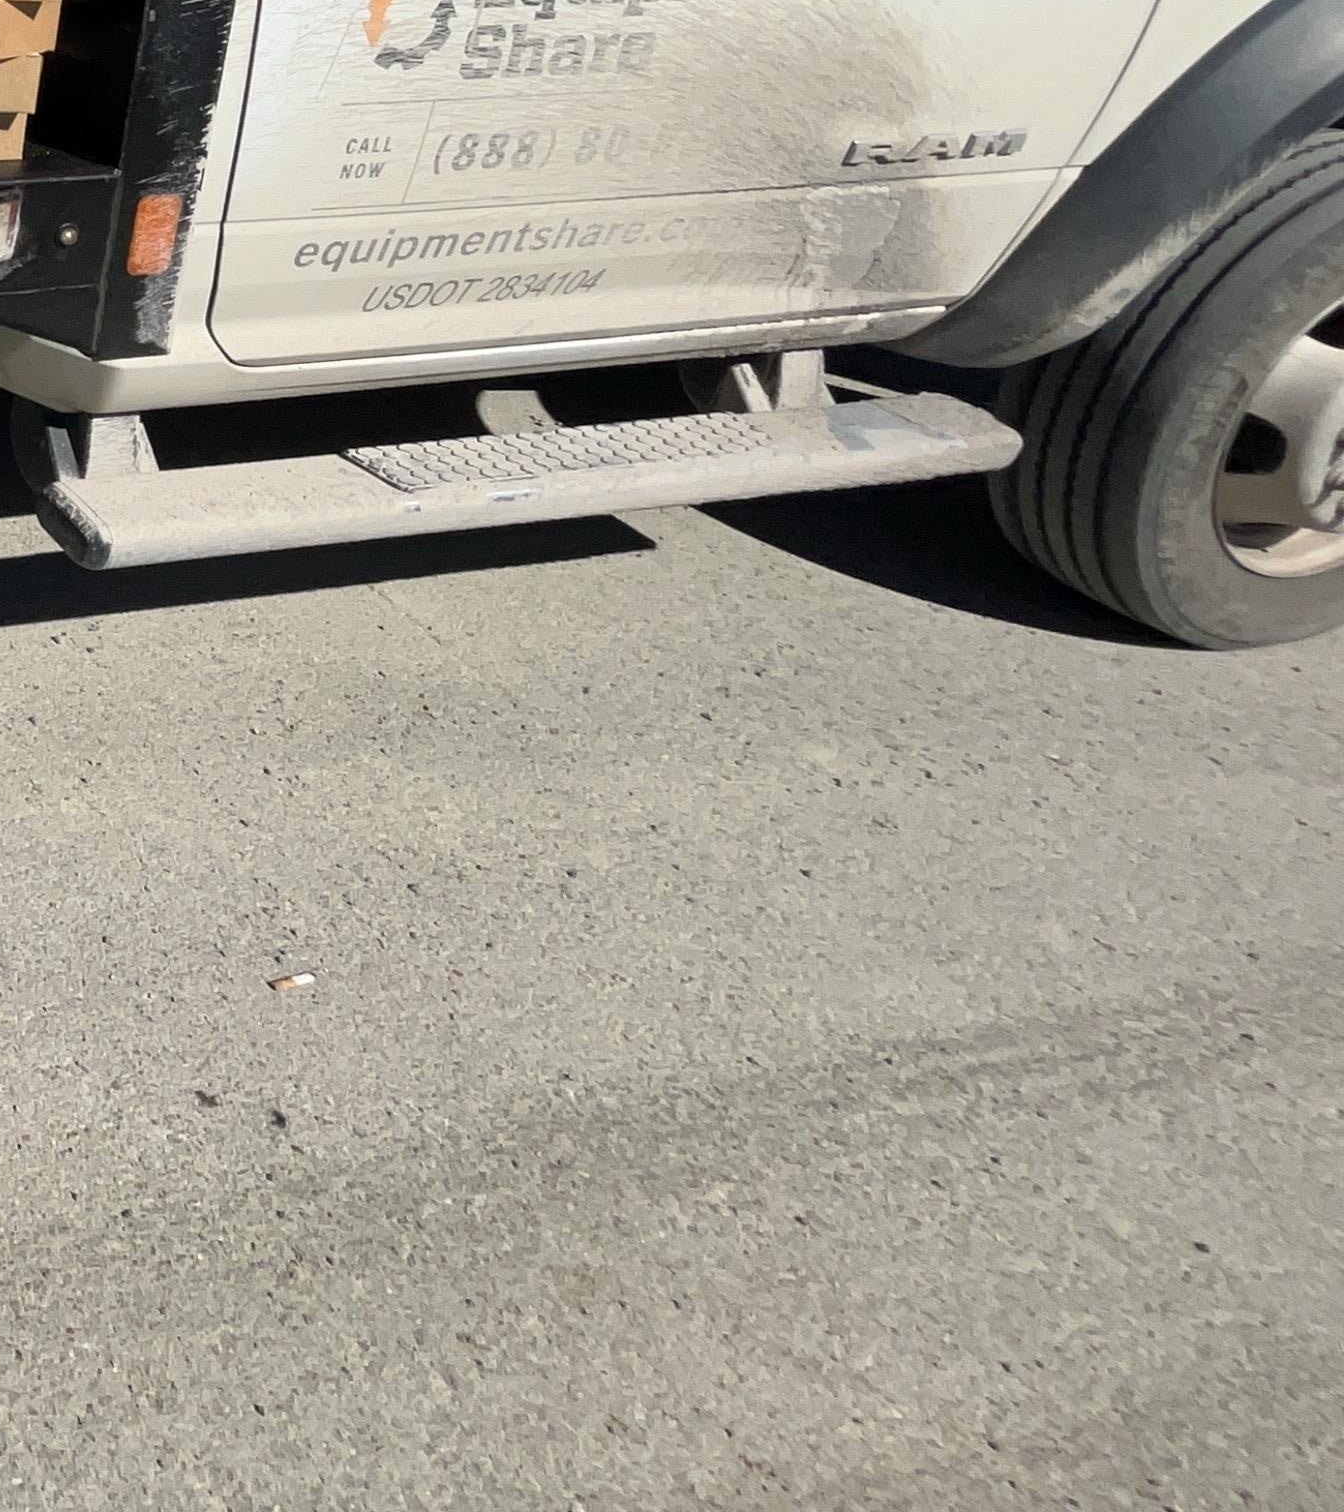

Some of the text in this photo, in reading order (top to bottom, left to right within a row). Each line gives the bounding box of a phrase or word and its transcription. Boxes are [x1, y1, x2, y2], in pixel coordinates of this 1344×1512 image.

[459, 23, 657, 80] Share
[345, 135, 392, 155] CALL
[433, 128, 557, 176] (888)
[840, 127, 1028, 167] RAM
[339, 162, 385, 180] NOW
[361, 267, 608, 313] USDOT 2834104
